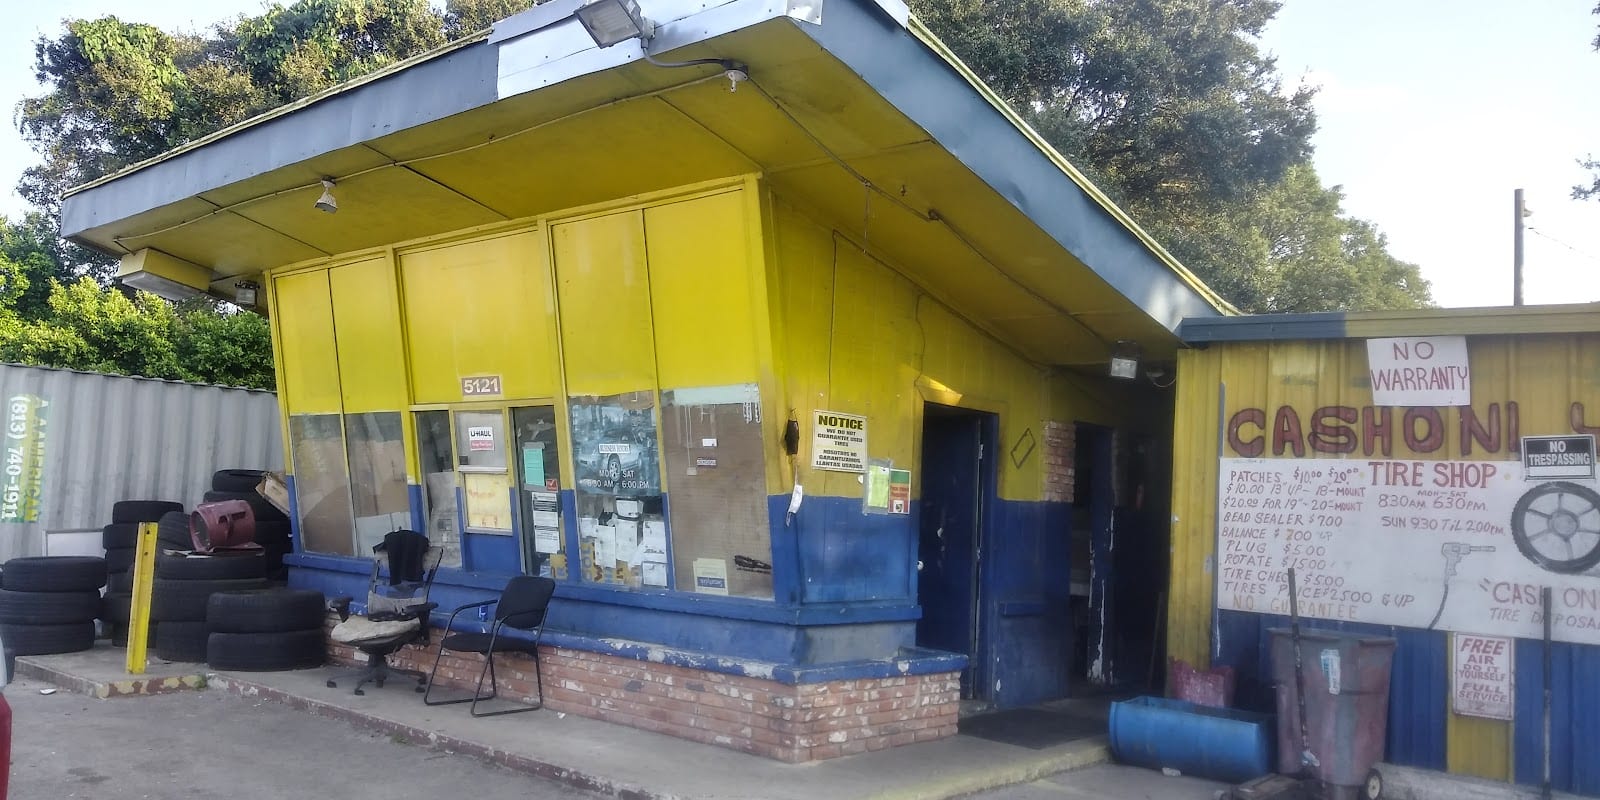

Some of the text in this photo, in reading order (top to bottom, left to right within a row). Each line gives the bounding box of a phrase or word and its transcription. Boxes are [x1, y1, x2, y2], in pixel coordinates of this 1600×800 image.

[1393, 341, 1434, 360] NO
[1371, 365, 1468, 391] WARRANTY
[463, 378, 500, 395] 5121
[818, 415, 863, 430] NOTICE
[1227, 405, 1392, 457] CASH
[823, 449, 850, 457] NOSOTROS
[1549, 440, 1567, 453] NO
[1, 396, 31, 519] (813) 740-1911
[1528, 452, 1591, 466] TRESPASSING
[622, 470, 635, 478] SAT
[1230, 470, 1282, 484] PATCHES
[1368, 461, 1497, 488] TIRE SHOP
[604, 480, 614, 488] AM
[639, 481, 650, 489] PM
[1226, 481, 1264, 494] $10.00
[1262, 498, 1281, 509] FOR
[1223, 512, 1251, 523] BEAD
[1254, 512, 1304, 526] SEALER
[1381, 515, 1407, 528] SUN
[1221, 527, 1266, 539] BALANCE
[1226, 539, 1267, 554] PLUG
[1224, 553, 1272, 568] ROTATE
[1223, 567, 1252, 582] TIRE
[1257, 570, 1296, 584] CHEC
[1223, 581, 1267, 595] TIRES
[1278, 584, 1323, 600] PICE
[1394, 593, 1415, 608] UP
[1563, 587, 1600, 611] ON
[1232, 594, 1360, 620] NO GURANTEE
[1489, 607, 1600, 631] TIRE DPOSA
[1460, 637, 1506, 655] FREE
[1467, 654, 1495, 665] AIR
[1459, 670, 1506, 682] YOURSELF
[1462, 682, 1504, 694] FULL
[1459, 690, 1508, 703] SERVICE
